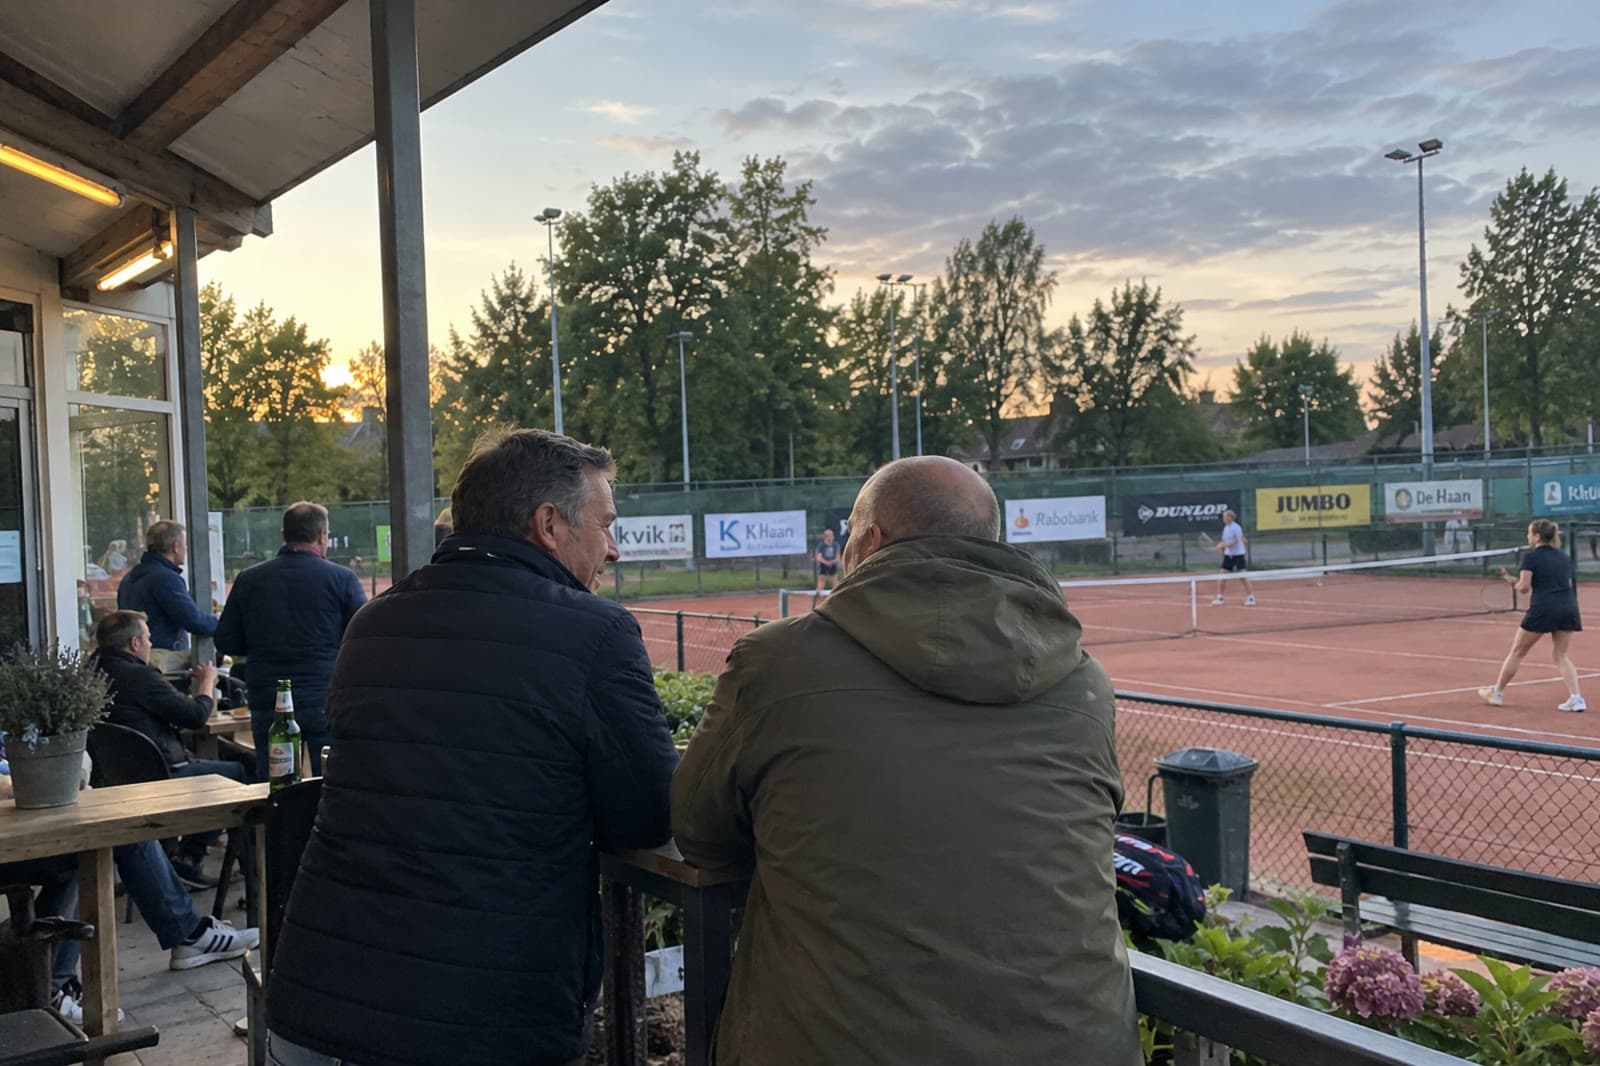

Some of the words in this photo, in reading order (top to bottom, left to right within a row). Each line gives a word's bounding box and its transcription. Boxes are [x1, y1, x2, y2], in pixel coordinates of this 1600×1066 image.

[1276, 493, 1351, 513] JUMBO
[1416, 490, 1433, 505] De
[1437, 488, 1471, 504] Haan
[1035, 508, 1099, 527] Rabobank
[1154, 504, 1228, 518] DUNLOP
[618, 525, 664, 545] kvik
